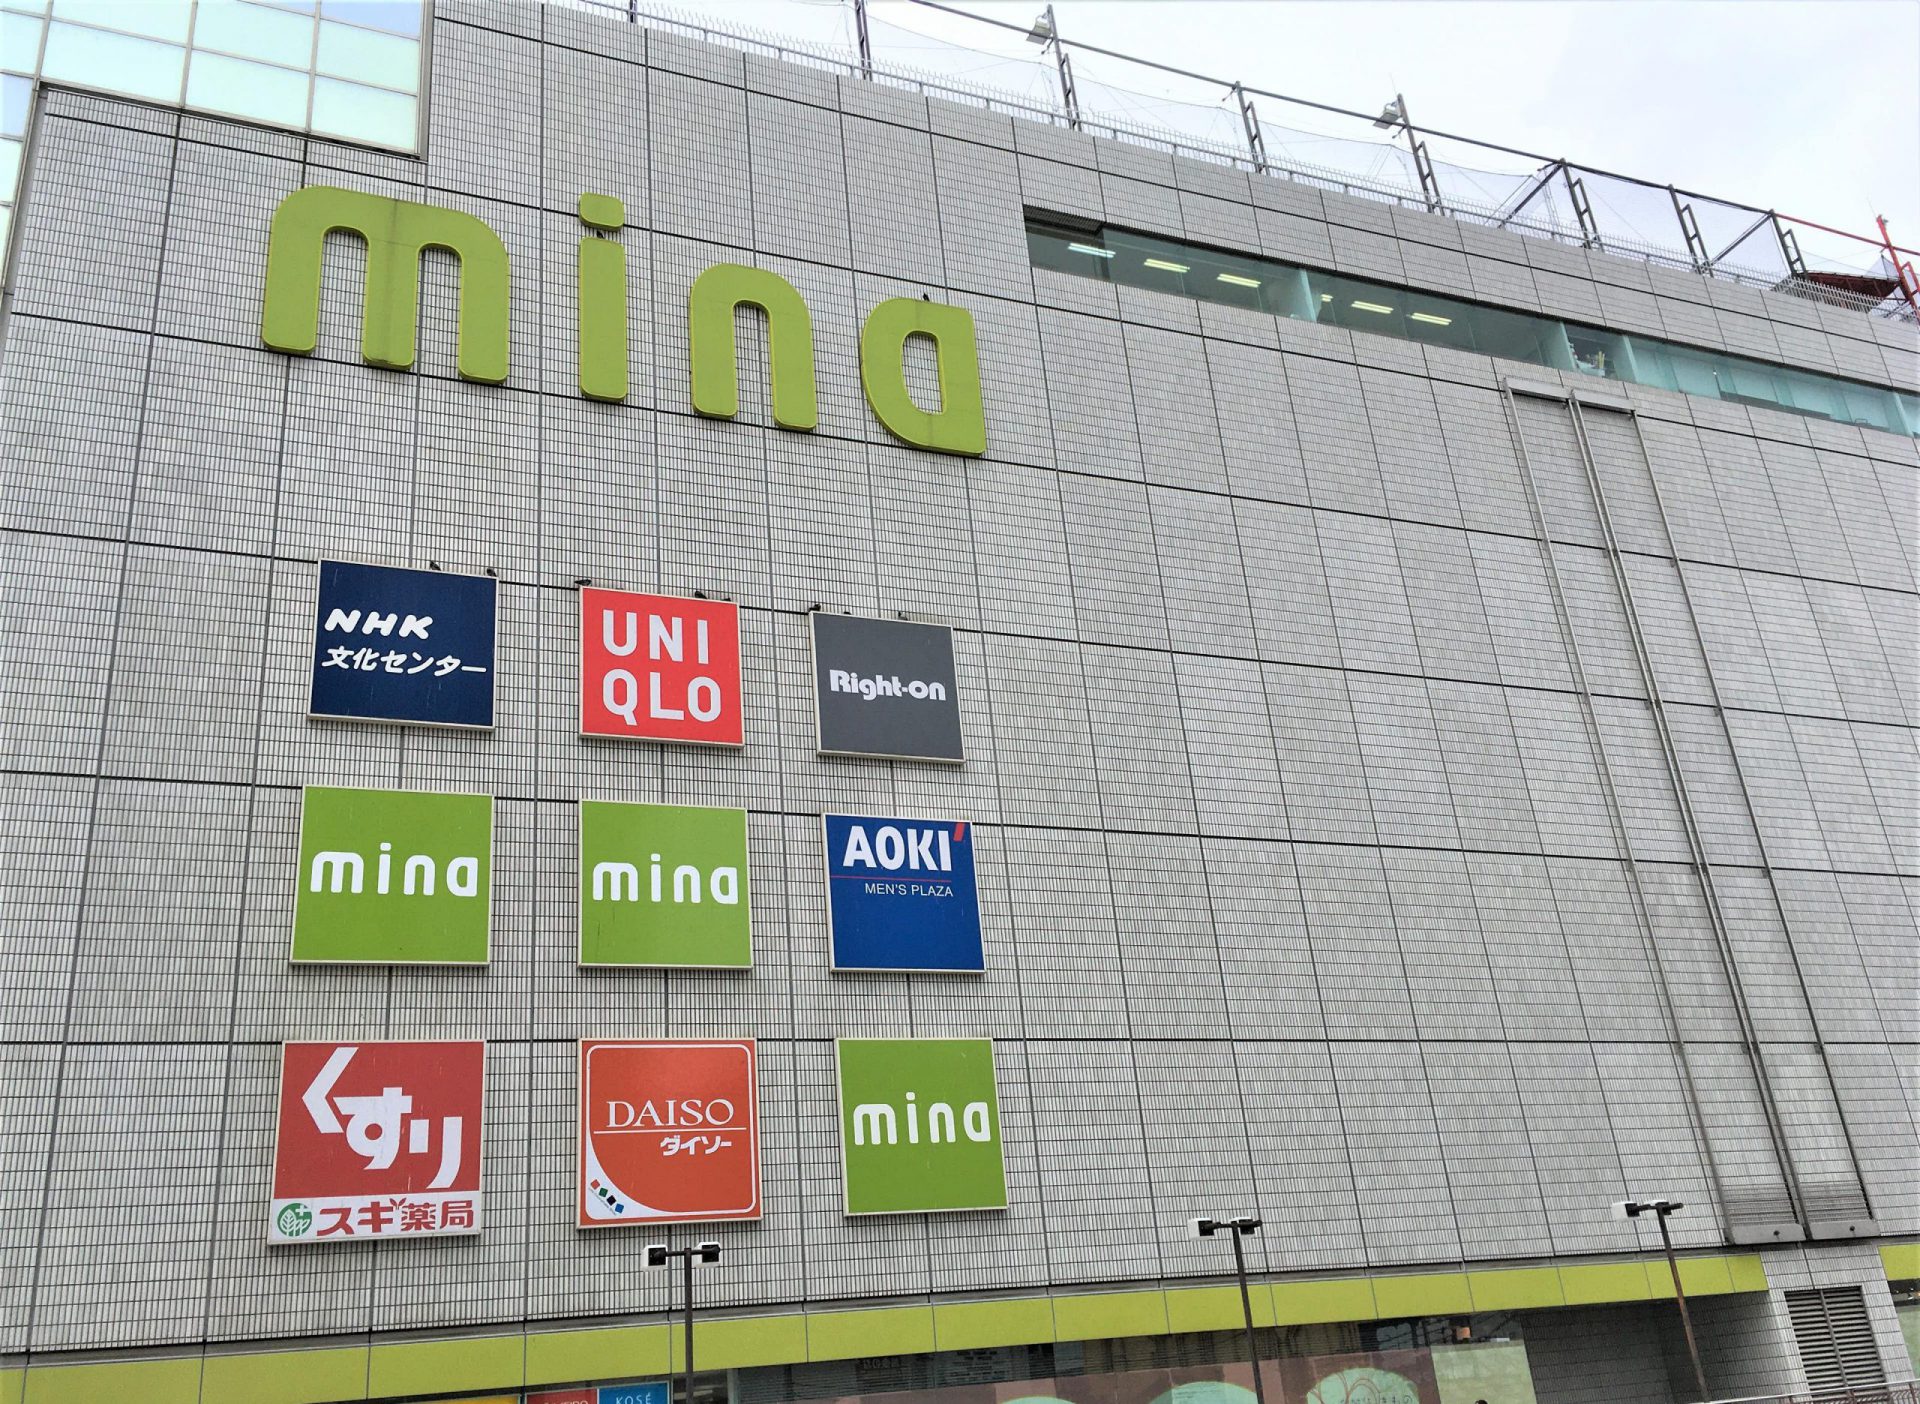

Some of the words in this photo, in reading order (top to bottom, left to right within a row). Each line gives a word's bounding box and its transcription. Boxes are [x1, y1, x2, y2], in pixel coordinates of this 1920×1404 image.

[262, 186, 986, 456] mina
[325, 608, 434, 640] NHK
[602, 609, 710, 664] UNI
[321, 645, 487, 677] 文化センター
[602, 668, 722, 726] QLO
[829, 669, 947, 702] Right-on
[310, 842, 479, 897] mina
[592, 853, 739, 905] mina
[865, 883, 906, 896] MEN'S
[911, 884, 954, 897] PLAZA
[301, 1046, 463, 1189] くすり
[607, 1098, 735, 1128] DAISO
[853, 1091, 991, 1146] mina
[660, 1134, 733, 1156] ダイソー
[316, 1198, 475, 1237] スギ薬局
